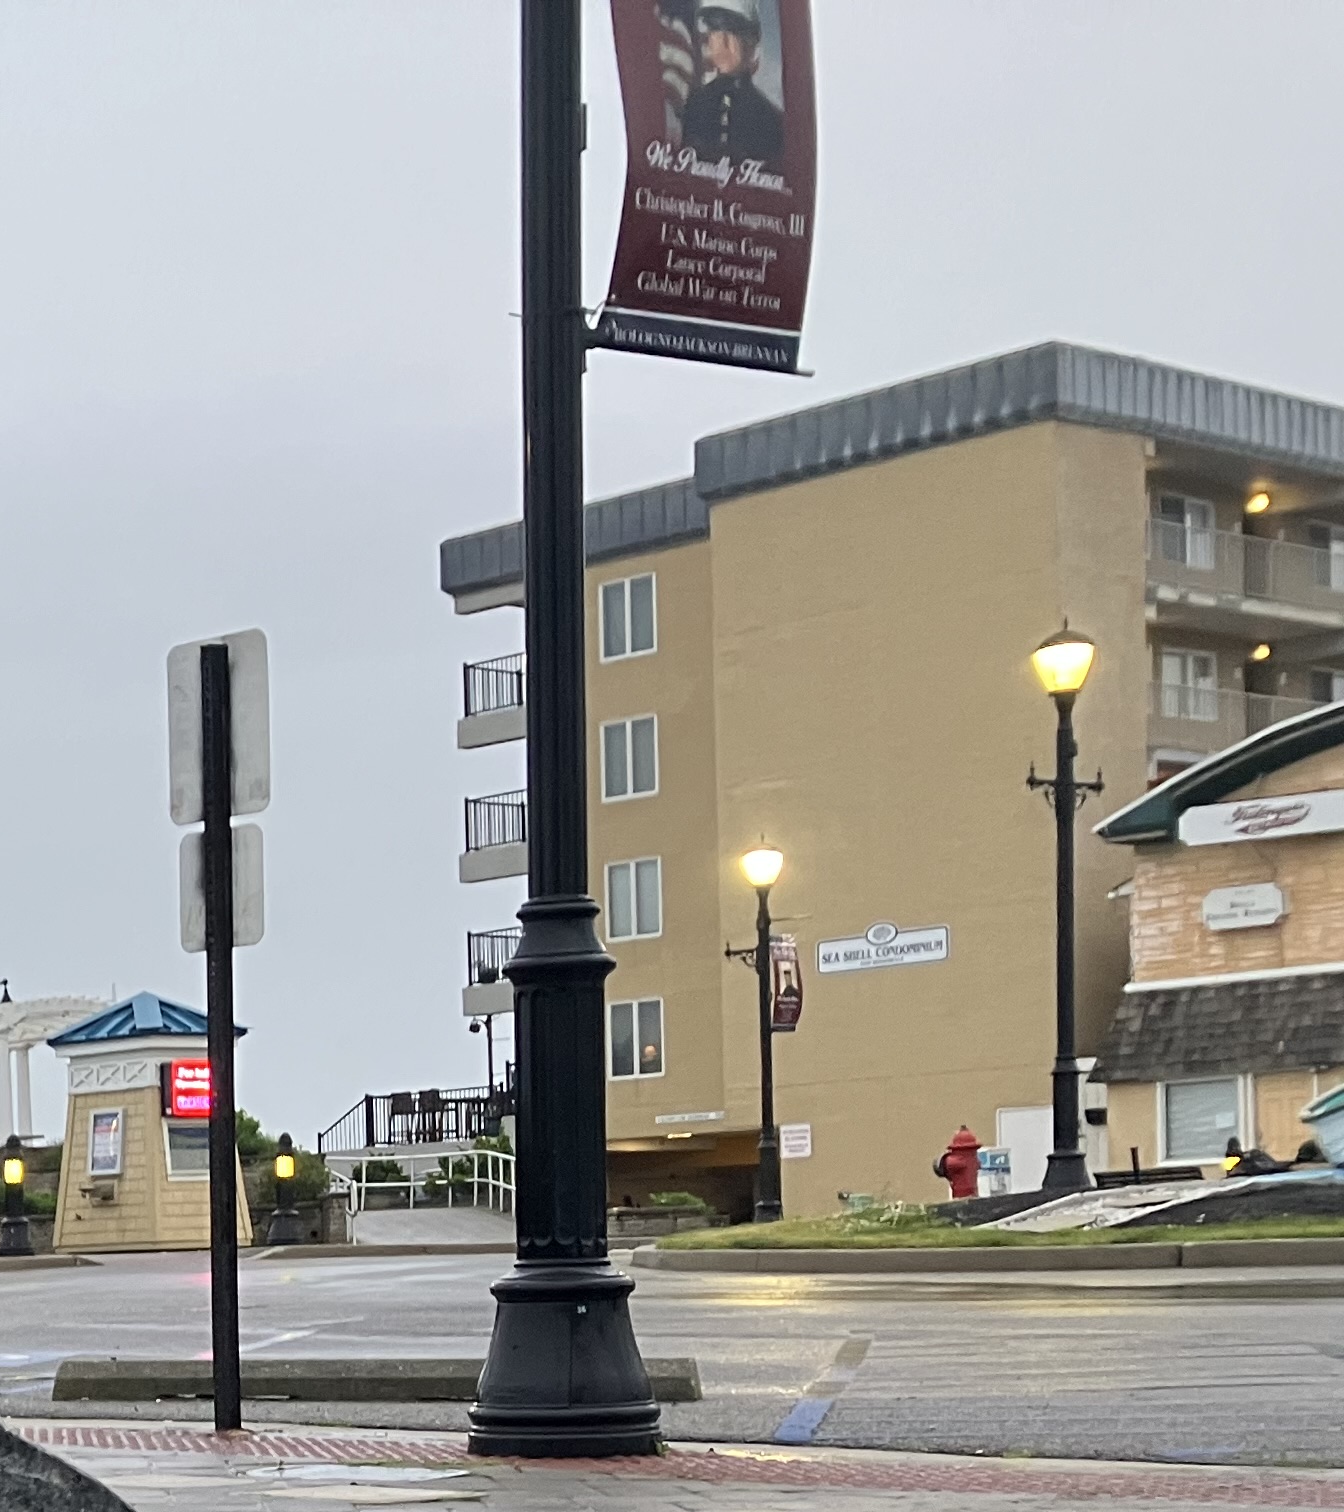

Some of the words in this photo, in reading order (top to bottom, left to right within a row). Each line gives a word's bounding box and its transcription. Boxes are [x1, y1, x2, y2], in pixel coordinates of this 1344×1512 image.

[646, 140, 673, 171] We
[635, 186, 710, 220] Christopher
[694, 228, 737, 254] Marine
[741, 237, 778, 262] Corps
[637, 270, 685, 296] Global
[709, 257, 767, 285] Corporal
[821, 952, 840, 964] SEA
